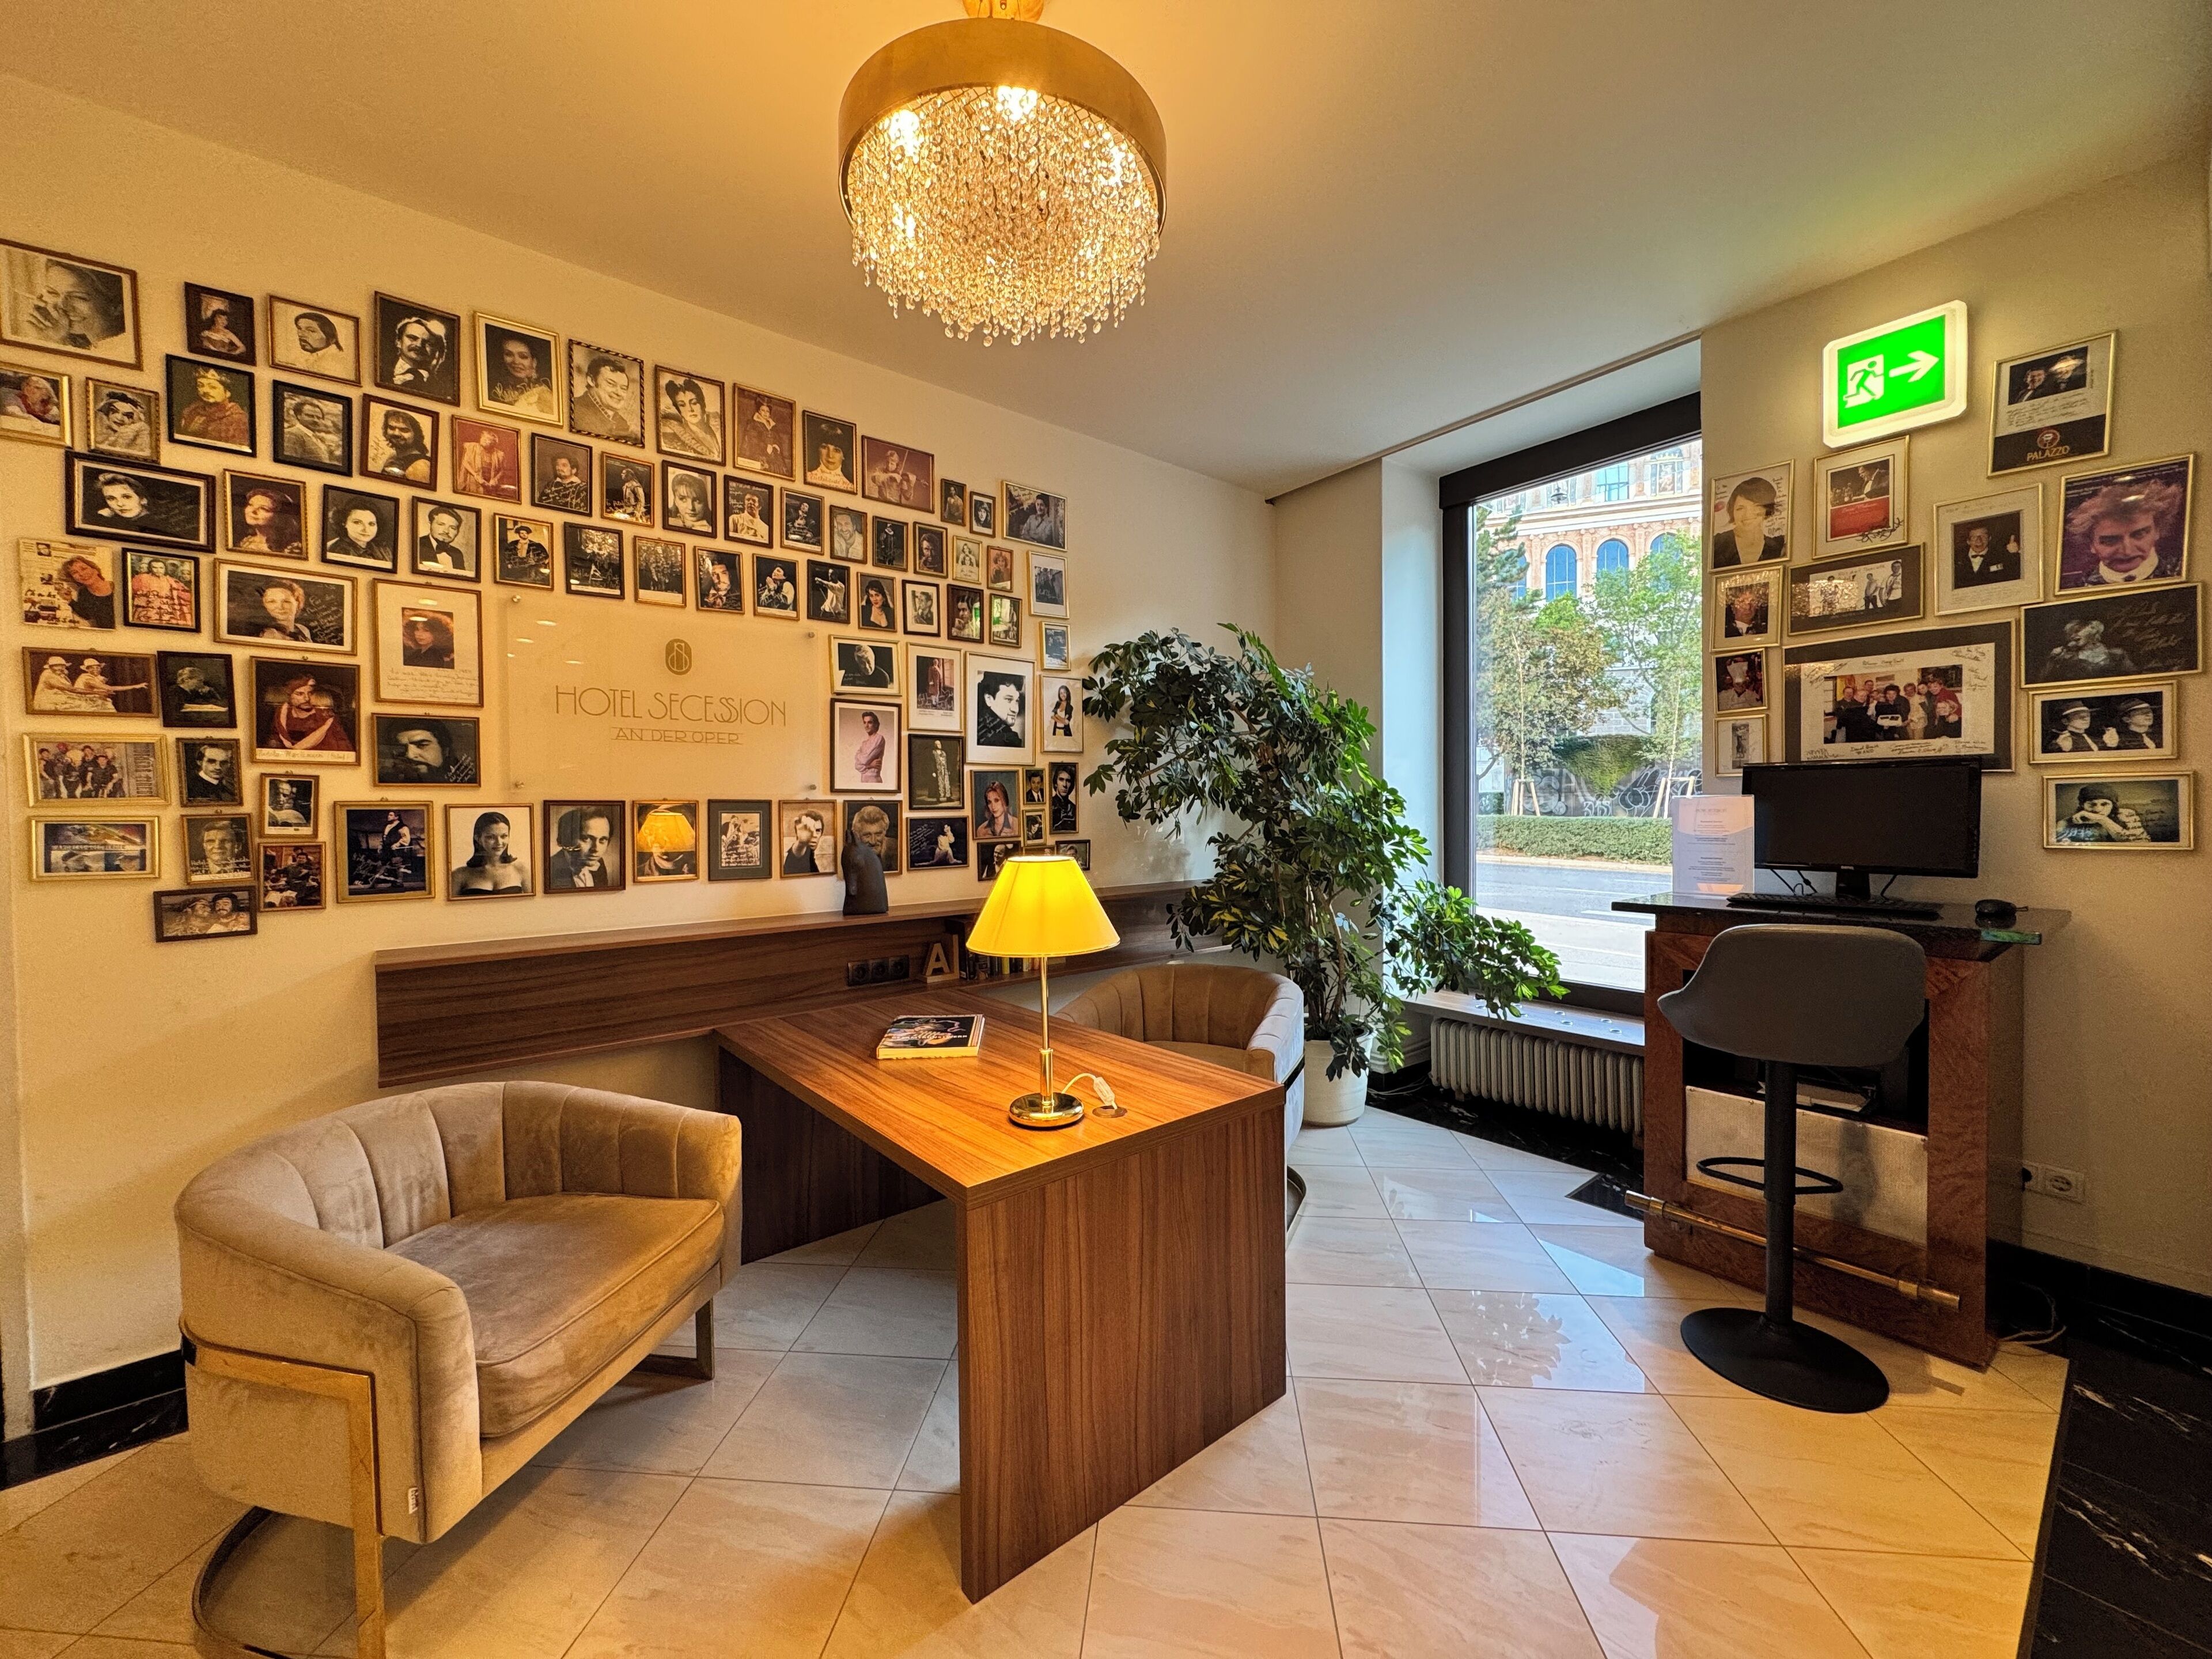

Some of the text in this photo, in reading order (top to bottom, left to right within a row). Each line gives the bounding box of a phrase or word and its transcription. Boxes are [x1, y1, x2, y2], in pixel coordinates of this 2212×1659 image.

[2027, 445, 2070, 461] PALAZZO
[555, 685, 786, 726] HOTEL SECESSION
[615, 728, 739, 745] AN DER OPER
